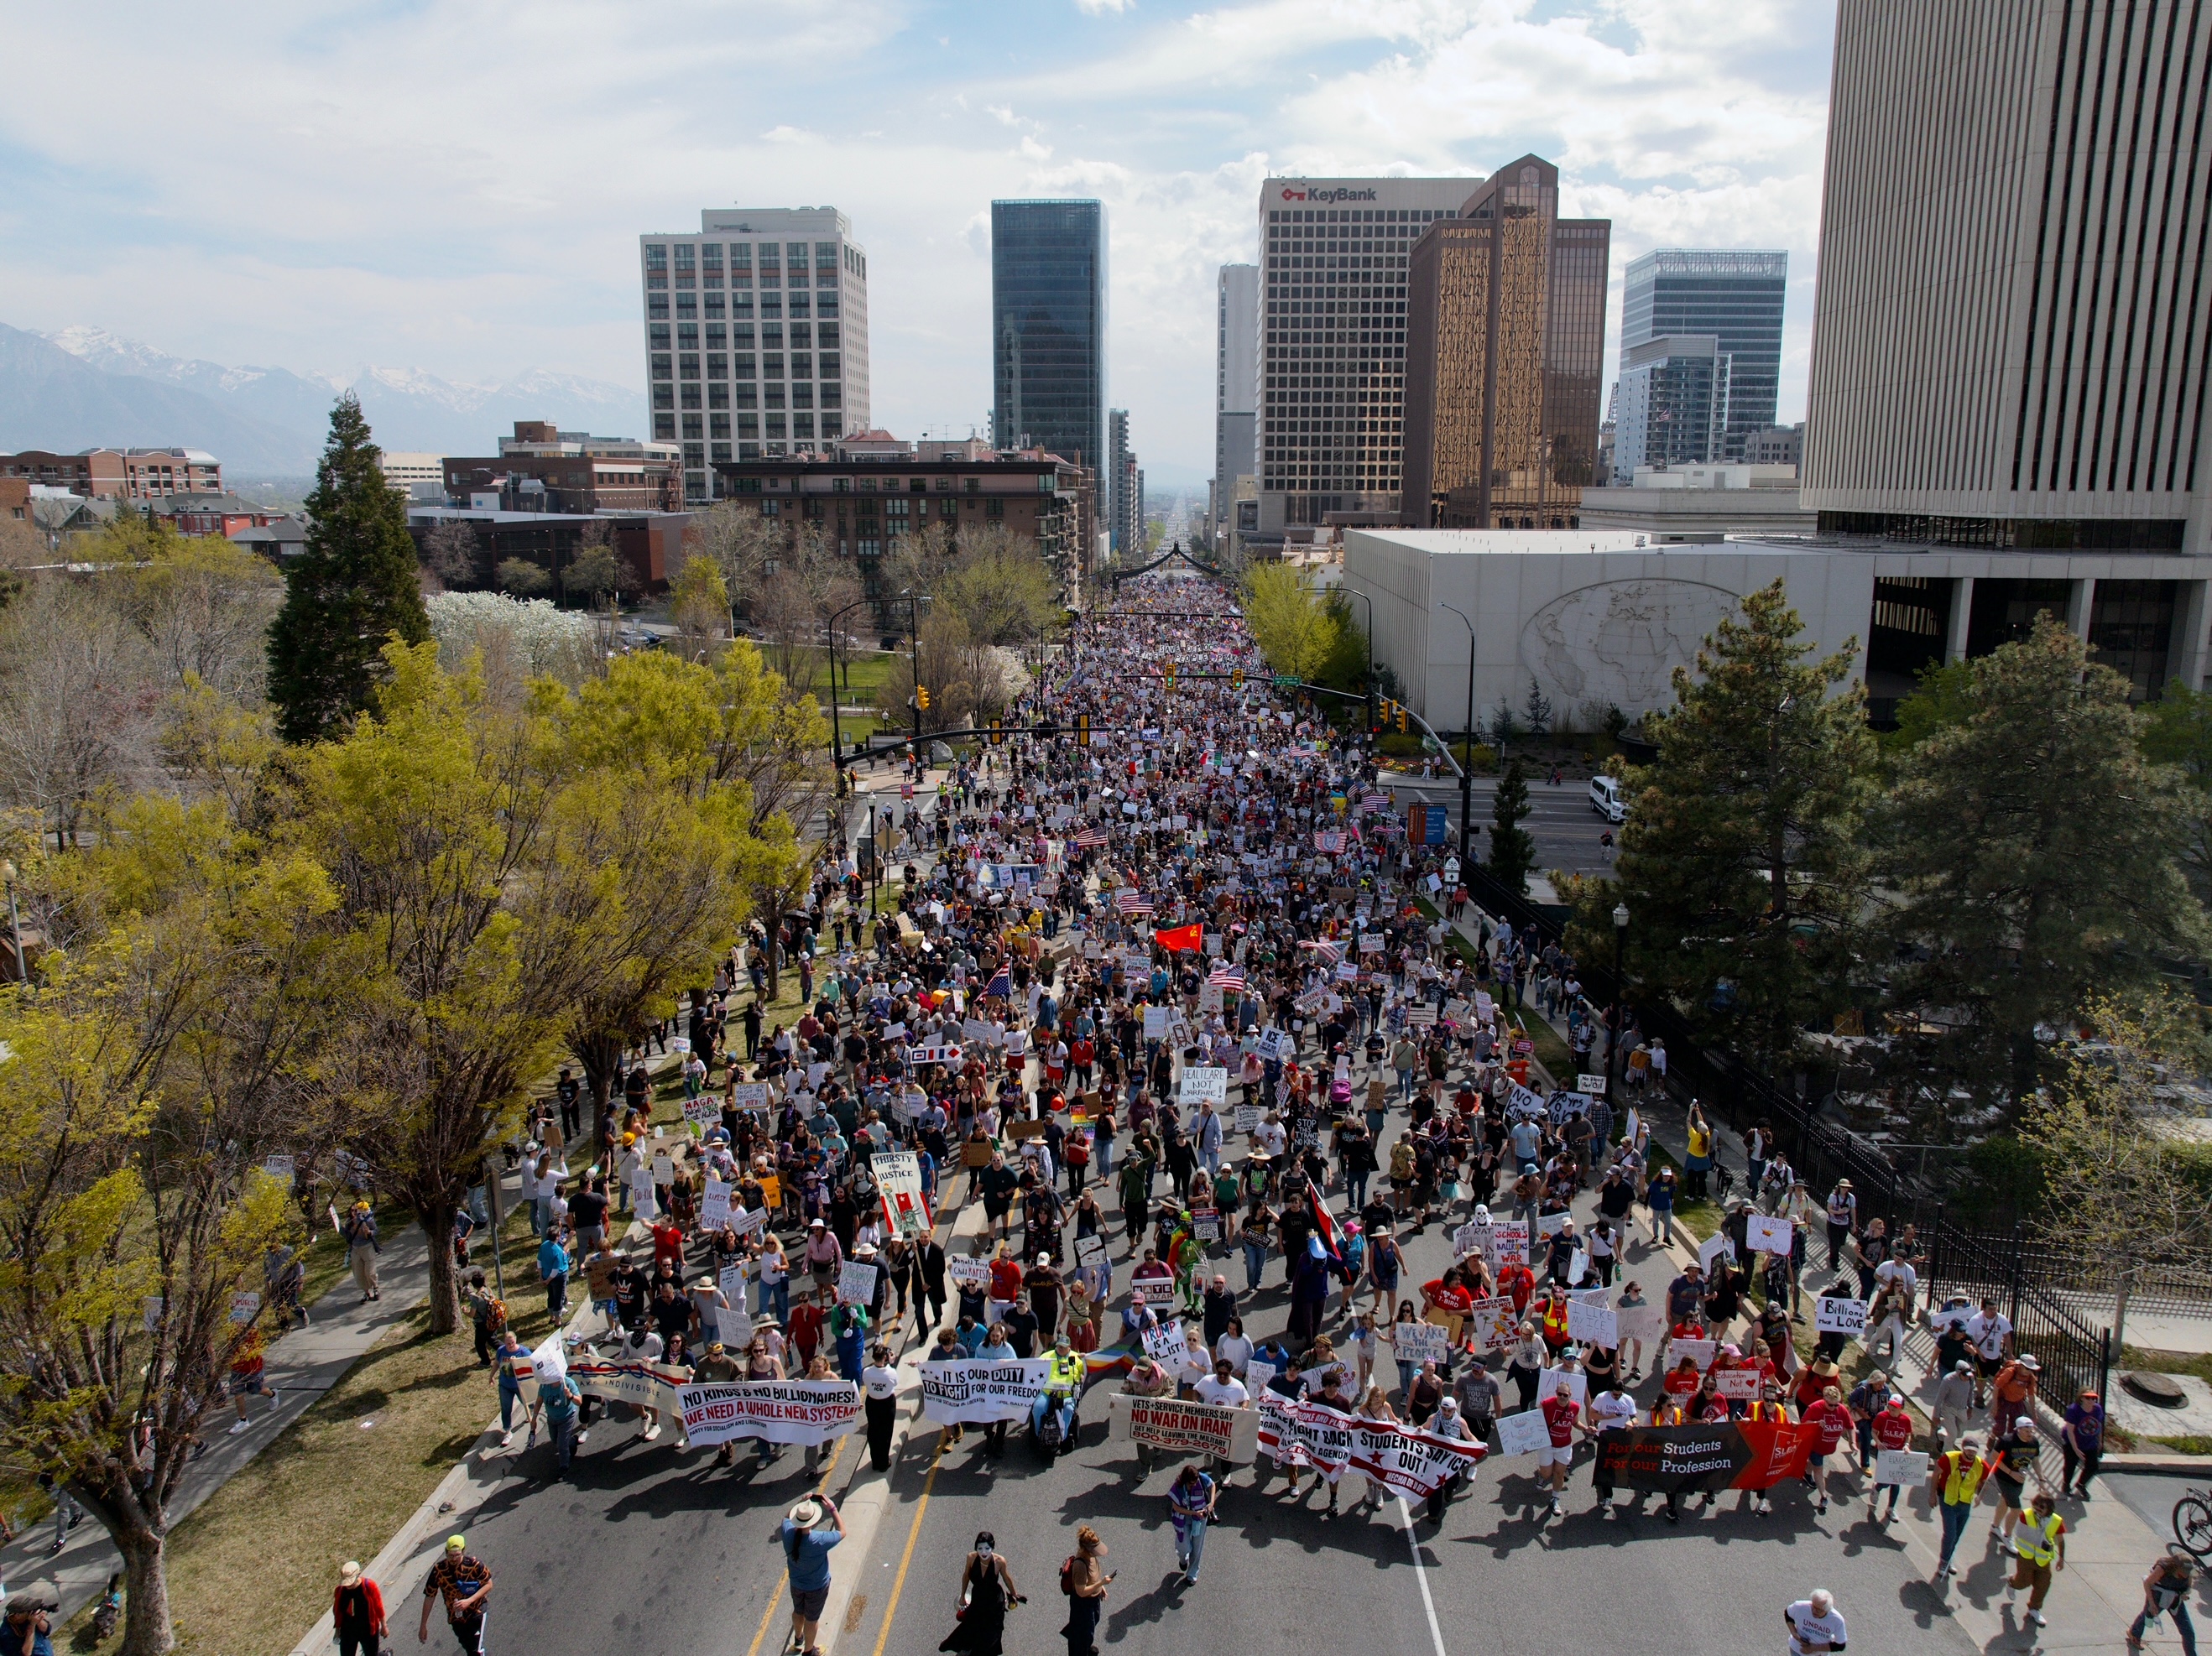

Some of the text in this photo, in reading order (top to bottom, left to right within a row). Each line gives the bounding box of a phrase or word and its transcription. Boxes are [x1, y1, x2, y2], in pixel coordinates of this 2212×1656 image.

[1308, 187, 1376, 204] KeyBank
[1266, 1030, 1279, 1044] ICE
[1192, 1080, 1214, 1089] NOT
[685, 1097, 714, 1110] MAGA
[1513, 1089, 1532, 1106] NO
[702, 1110, 719, 1119] AGAIN
[1297, 1119, 1316, 1127] STOP
[873, 1154, 912, 1165] THIRSTY
[879, 1170, 913, 1181] JUSTICE
[953, 1256, 973, 1265] Donald
[844, 1263, 872, 1273] DENY
[954, 1267, 967, 1275] Child
[1438, 1298, 1458, 1308] T-BIRD
[1825, 1300, 1862, 1317] Billions
[1586, 1306, 1616, 1321] LIKE
[1587, 1316, 1606, 1331] ICE
[1837, 1316, 1863, 1329] LOVE
[1142, 1321, 1175, 1342] TRUMP
[1401, 1326, 1417, 1339] WE
[1426, 1327, 1444, 1339] ARE
[1570, 1324, 1613, 1344] CRUSHED
[1154, 1337, 1169, 1349] IS A
[1402, 1345, 1440, 1359] PEOPLE
[943, 1369, 1022, 1383] IT IS OUR DUTY
[1715, 1371, 1746, 1379] Education
[605, 1380, 660, 1398] INDIVISIBLE
[924, 1381, 937, 1394] TO
[939, 1384, 967, 1399] FIGHT
[972, 1384, 986, 1394] FOR
[989, 1384, 1005, 1394] OUR
[1730, 1379, 1742, 1387] Not
[683, 1387, 855, 1408] NO KINGS & NO BILLIONAIRES!
[685, 1401, 857, 1425] WE NEED A WHOLE NEW SYSTEM!
[1133, 1399, 1233, 1420] VETS+SERVICE MEMBERS SAY
[1131, 1409, 1232, 1437] NO WAR ON IRAN!
[1315, 1415, 1327, 1423] AND
[689, 1428, 703, 1436] PARTY
[712, 1424, 734, 1432] SOCIALISM
[746, 1420, 767, 1429] LIBERATION
[1512, 1427, 1534, 1438] LOVE
[1133, 1431, 1227, 1454] 800-379-2679
[1162, 1429, 1185, 1438] LEAVING
[1199, 1434, 1226, 1447] MILITARY
[1322, 1430, 1353, 1448] BACK
[1360, 1431, 1470, 1471] STUDENTS SAY ICE
[1607, 1441, 1722, 1455] For our Students
[1775, 1444, 1796, 1456] SLEA
[1604, 1457, 1731, 1474] For our Profession
[1385, 1472, 1406, 1486] MECHA
[1407, 1478, 1413, 1487] DE
[1417, 1483, 1423, 1492] OF
[1802, 1626, 1829, 1638] PROTESTER
[1803, 1619, 1831, 1634] UNPAID
